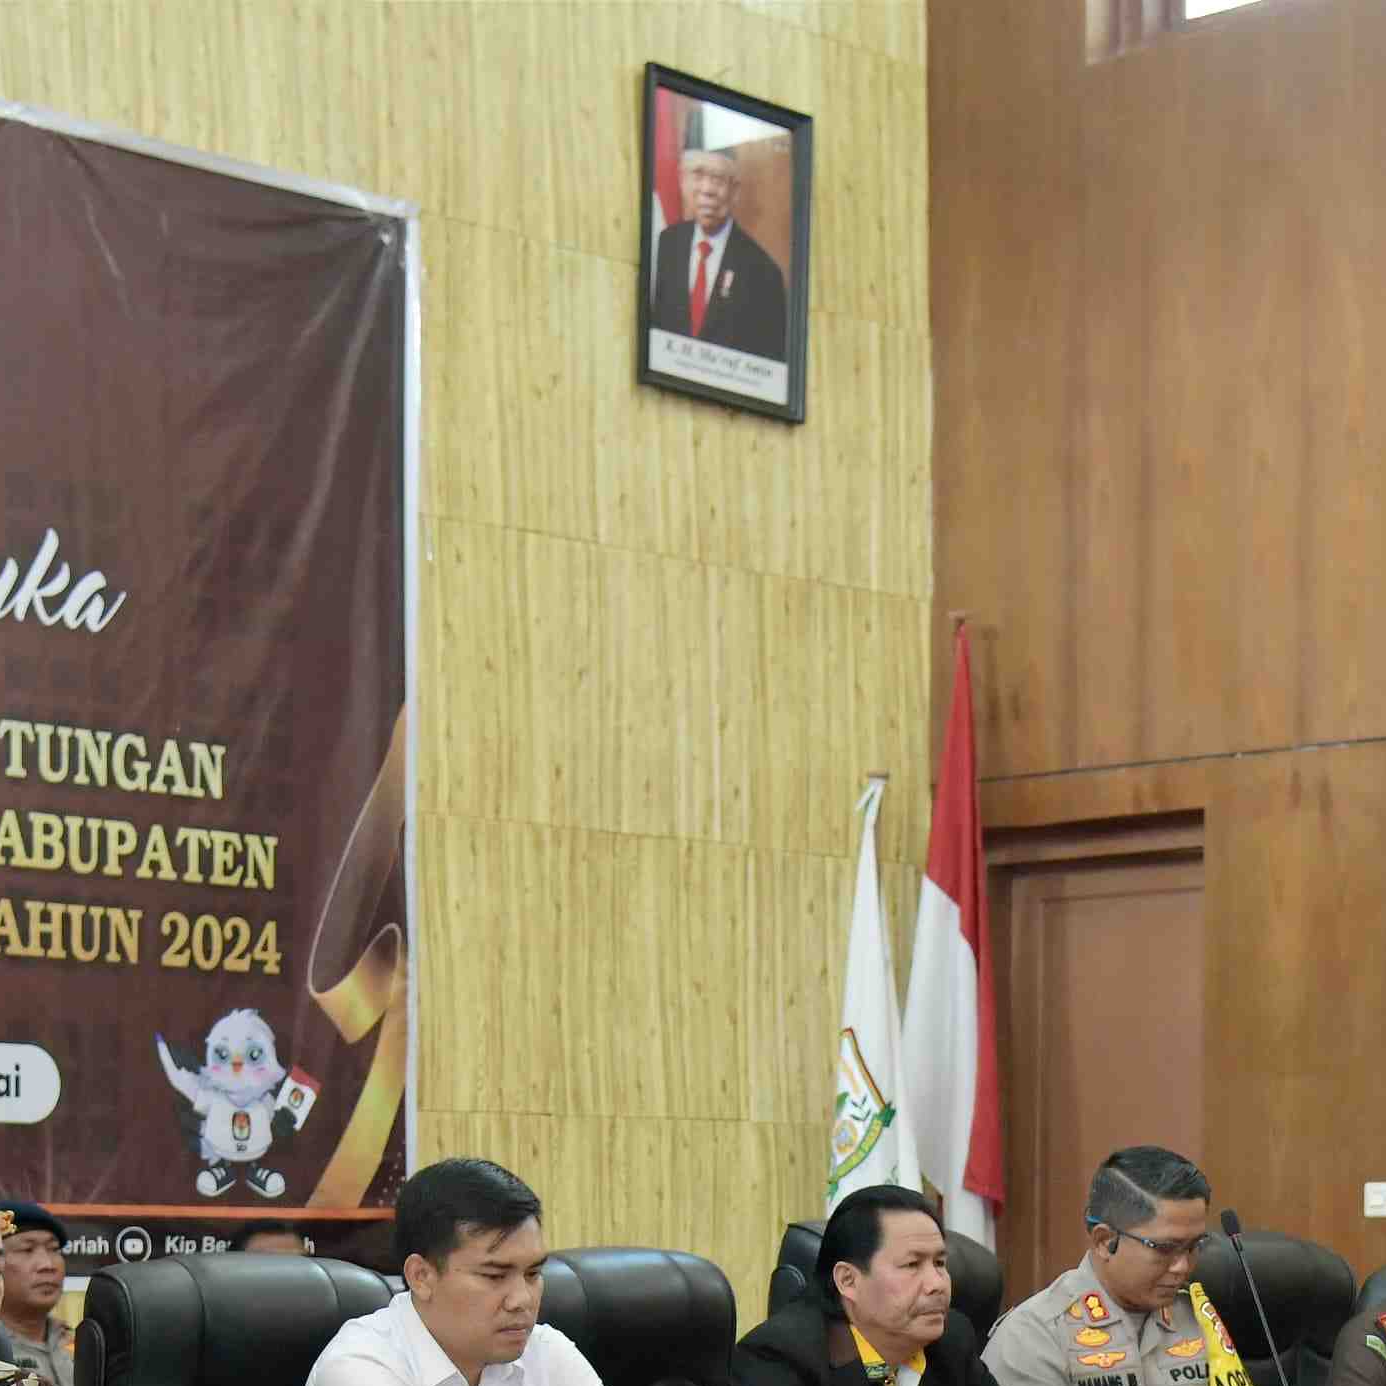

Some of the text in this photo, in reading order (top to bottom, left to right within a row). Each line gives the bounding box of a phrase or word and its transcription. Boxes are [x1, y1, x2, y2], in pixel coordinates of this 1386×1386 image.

[159, 911, 283, 976] 2024
[63, 1236, 110, 1256] eriah
[164, 1237, 197, 1257] Kip
